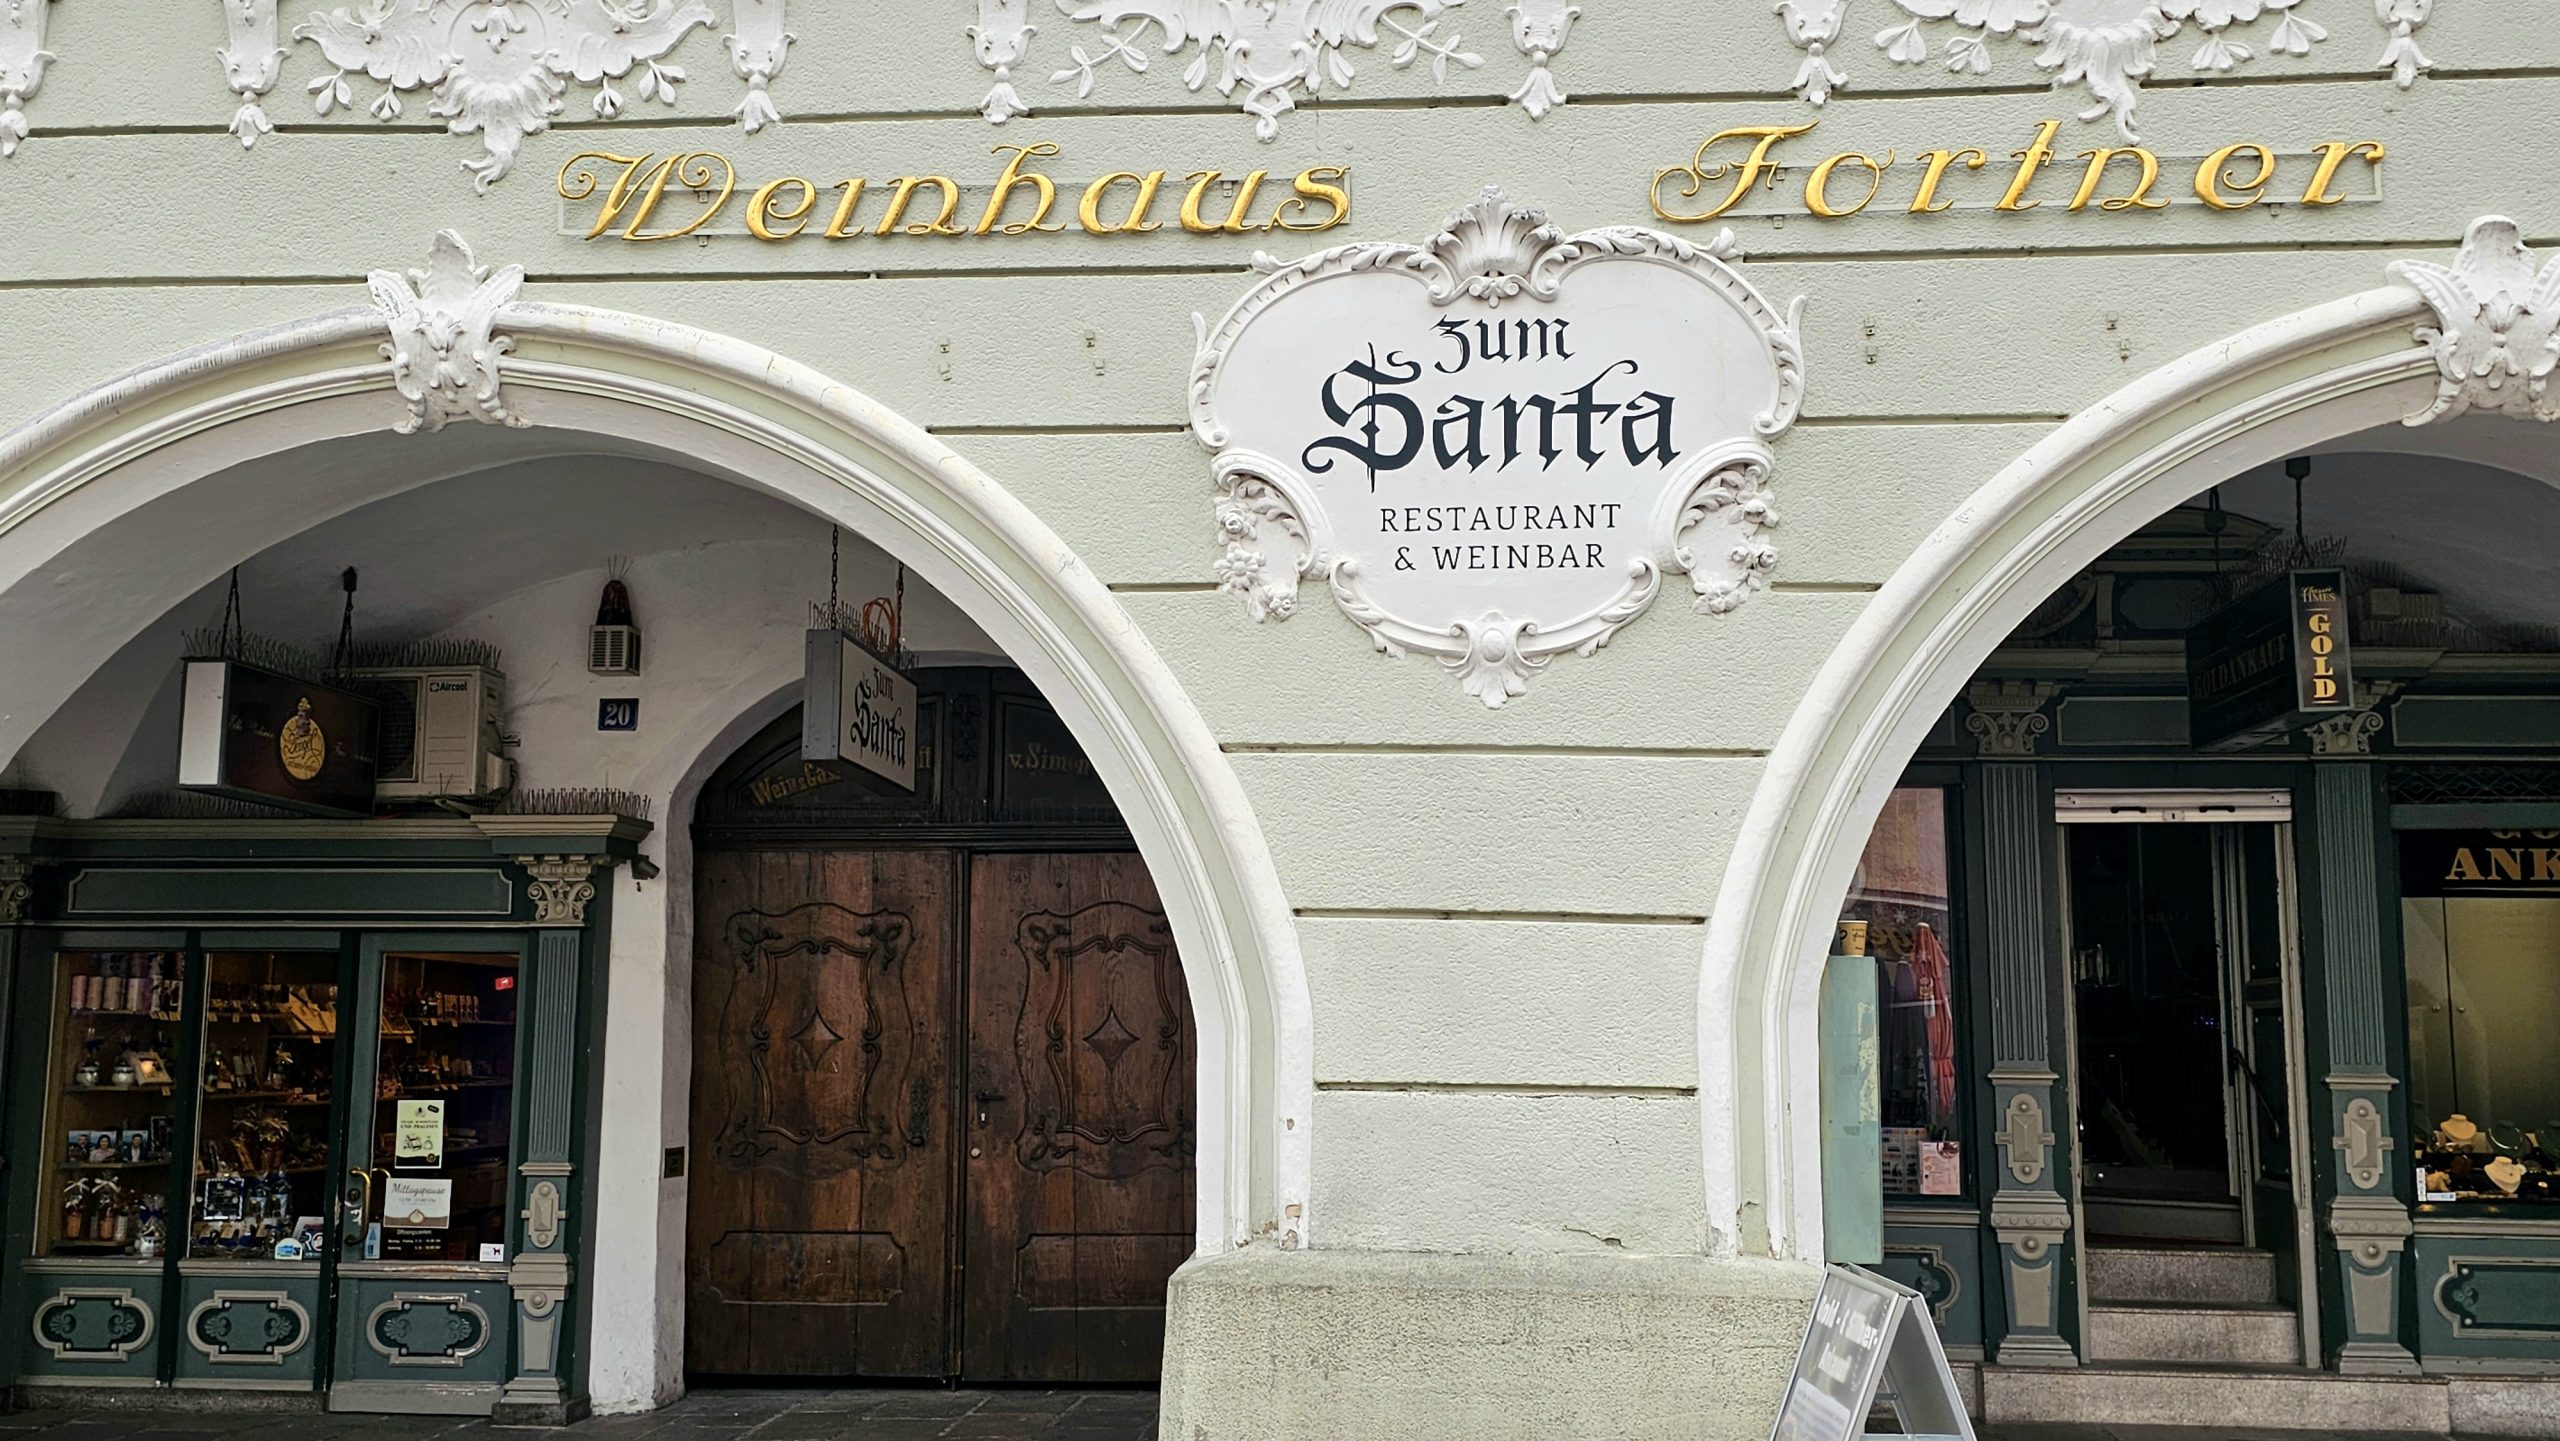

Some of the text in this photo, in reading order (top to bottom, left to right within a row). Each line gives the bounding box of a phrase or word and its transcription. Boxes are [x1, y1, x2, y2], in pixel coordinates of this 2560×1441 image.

[557, 119, 2386, 242] Weinhaus Fortner
[1429, 314, 1576, 373] zum
[1302, 342, 1682, 494] Santa
[1380, 504, 1622, 532] RESTAURANT
[1394, 543, 1606, 571] & WEINBAR
[2302, 592, 2337, 603] TIMES
[2194, 632, 2288, 698] GOLDANKAUF
[2308, 612, 2337, 699] GOLD
[439, 681, 469, 692] Aircool
[871, 666, 894, 702] zum
[604, 703, 631, 727] 20
[850, 671, 906, 768] Santa
[2444, 846, 2560, 881] ANK
[392, 1183, 446, 1197] Mittagspause
